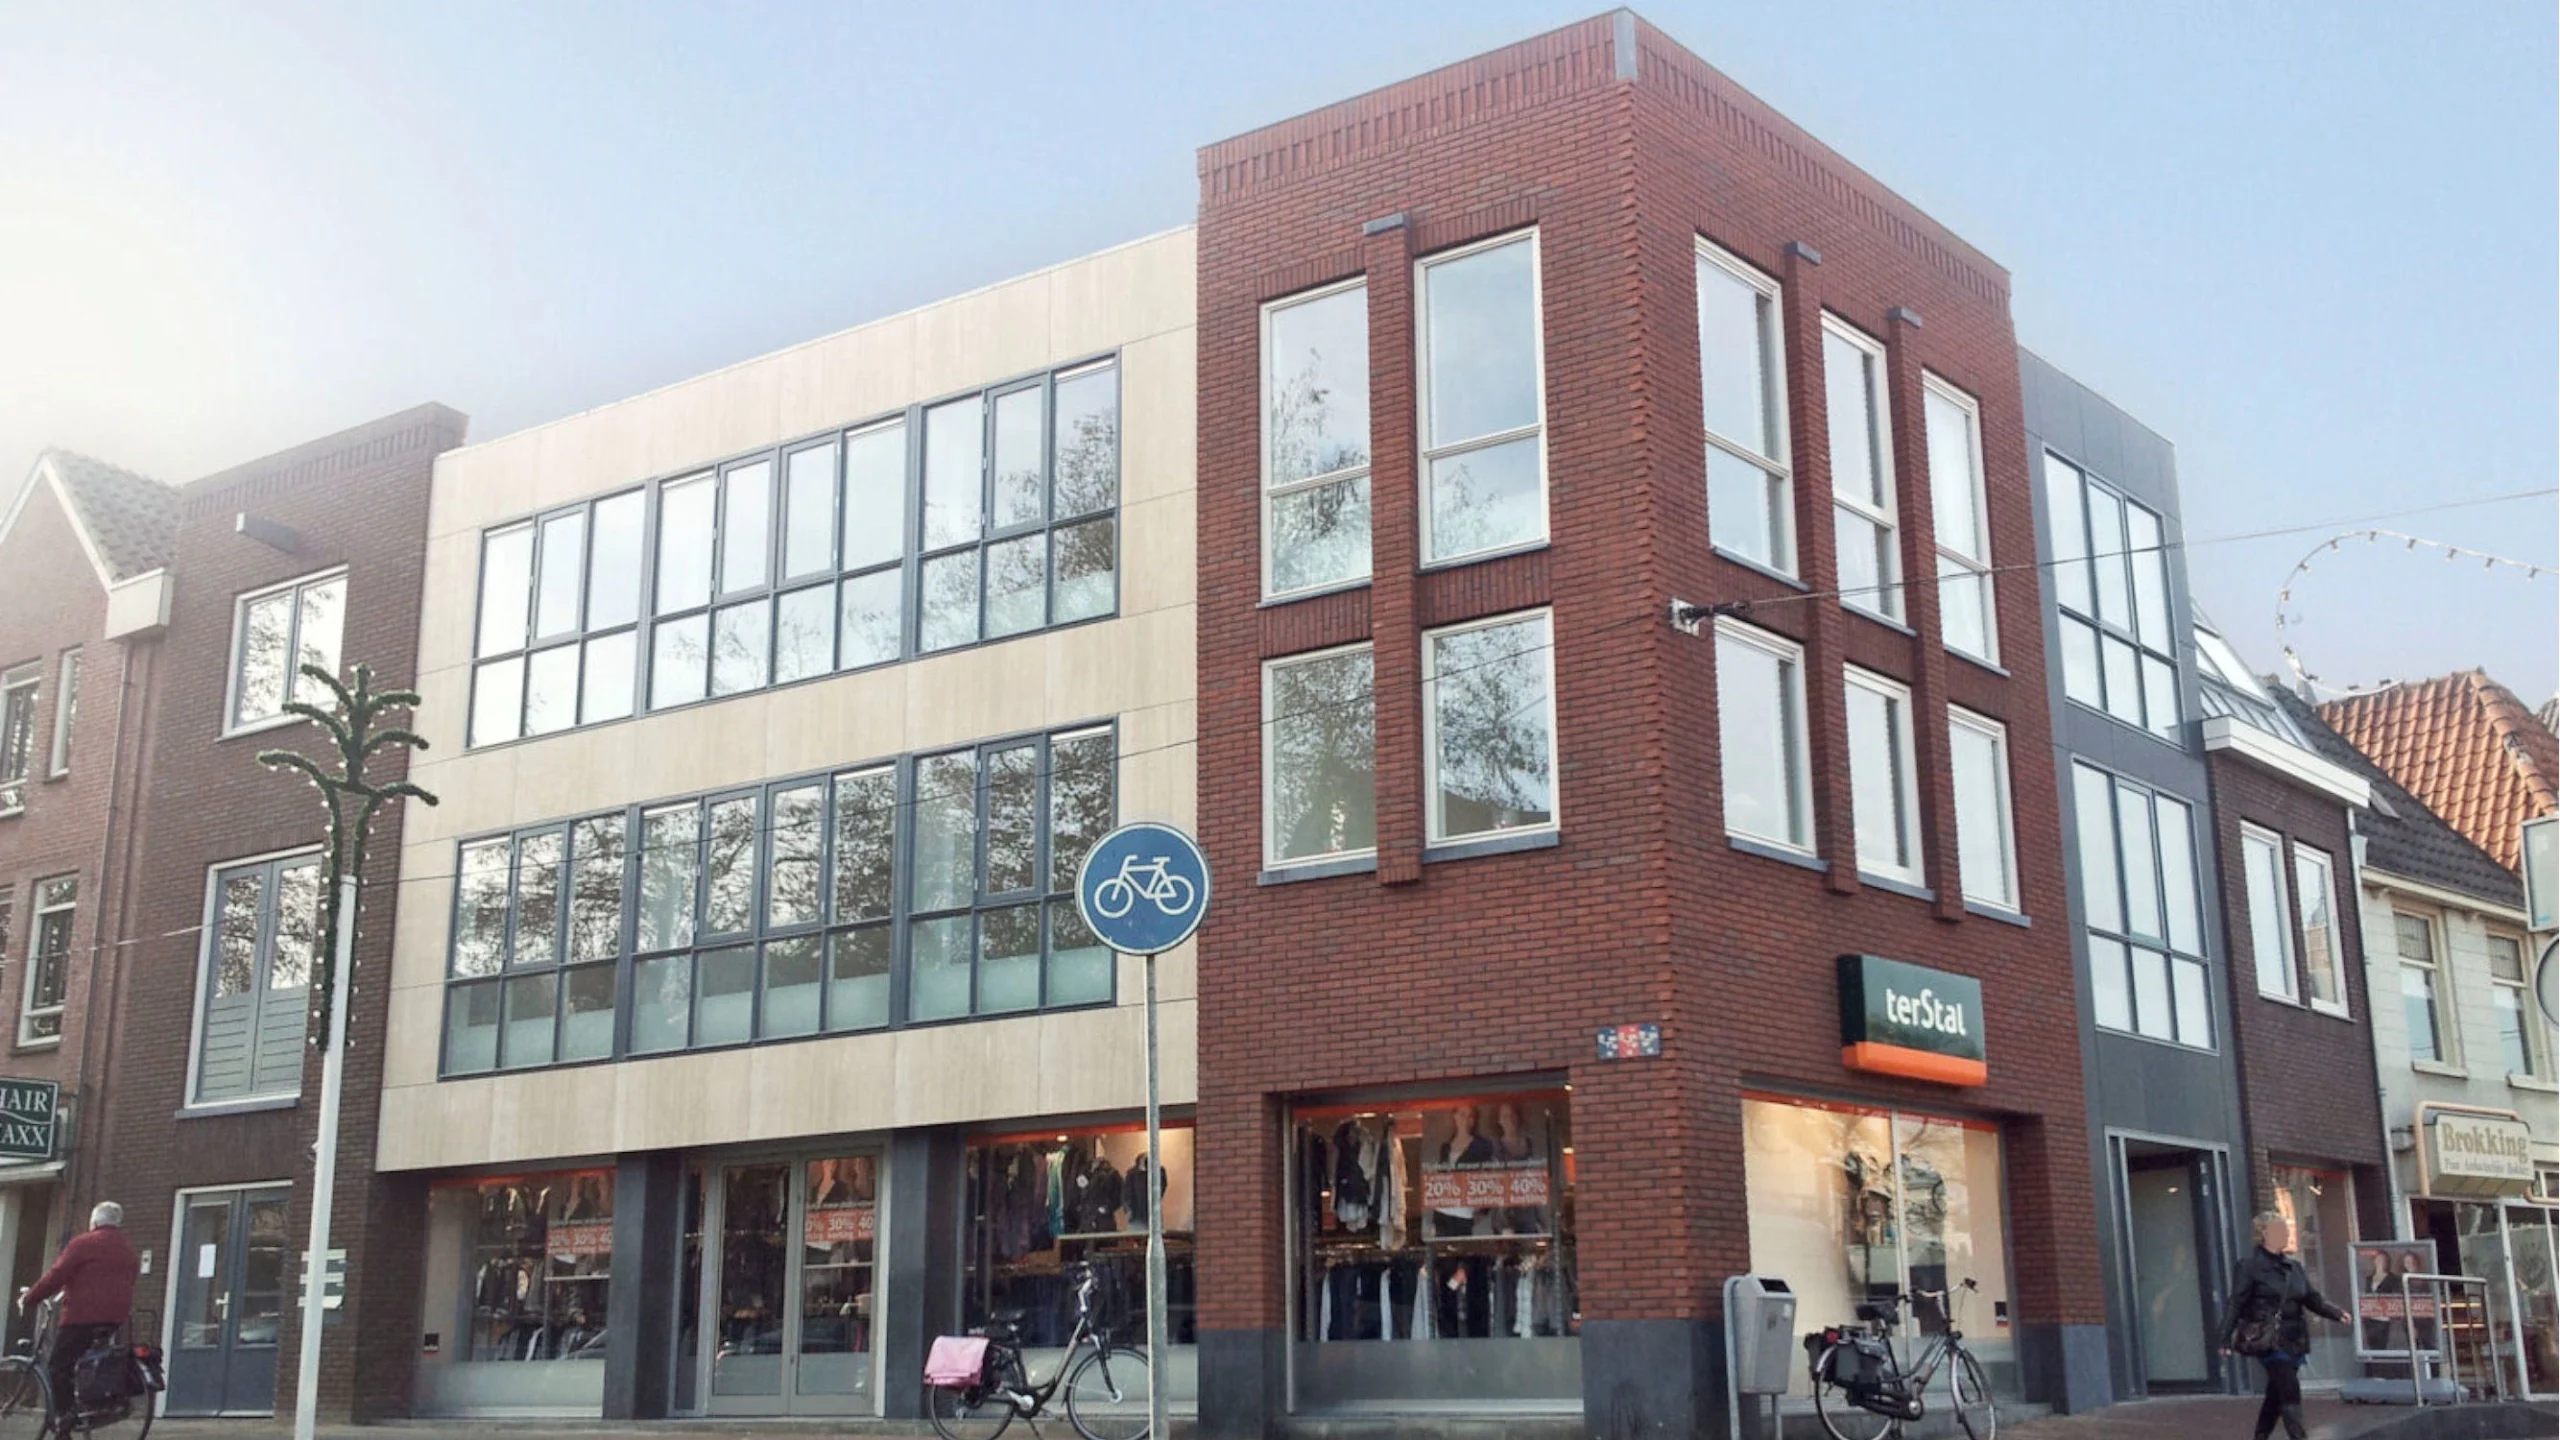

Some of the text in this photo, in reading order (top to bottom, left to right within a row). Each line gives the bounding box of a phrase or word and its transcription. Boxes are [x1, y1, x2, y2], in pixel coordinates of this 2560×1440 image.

[1885, 987, 1968, 1036] terStal
[0, 1123, 47, 1147] AXX
[2441, 1122, 2529, 1164] Brokking
[1424, 1177, 1547, 1197] 20% 30% 40%
